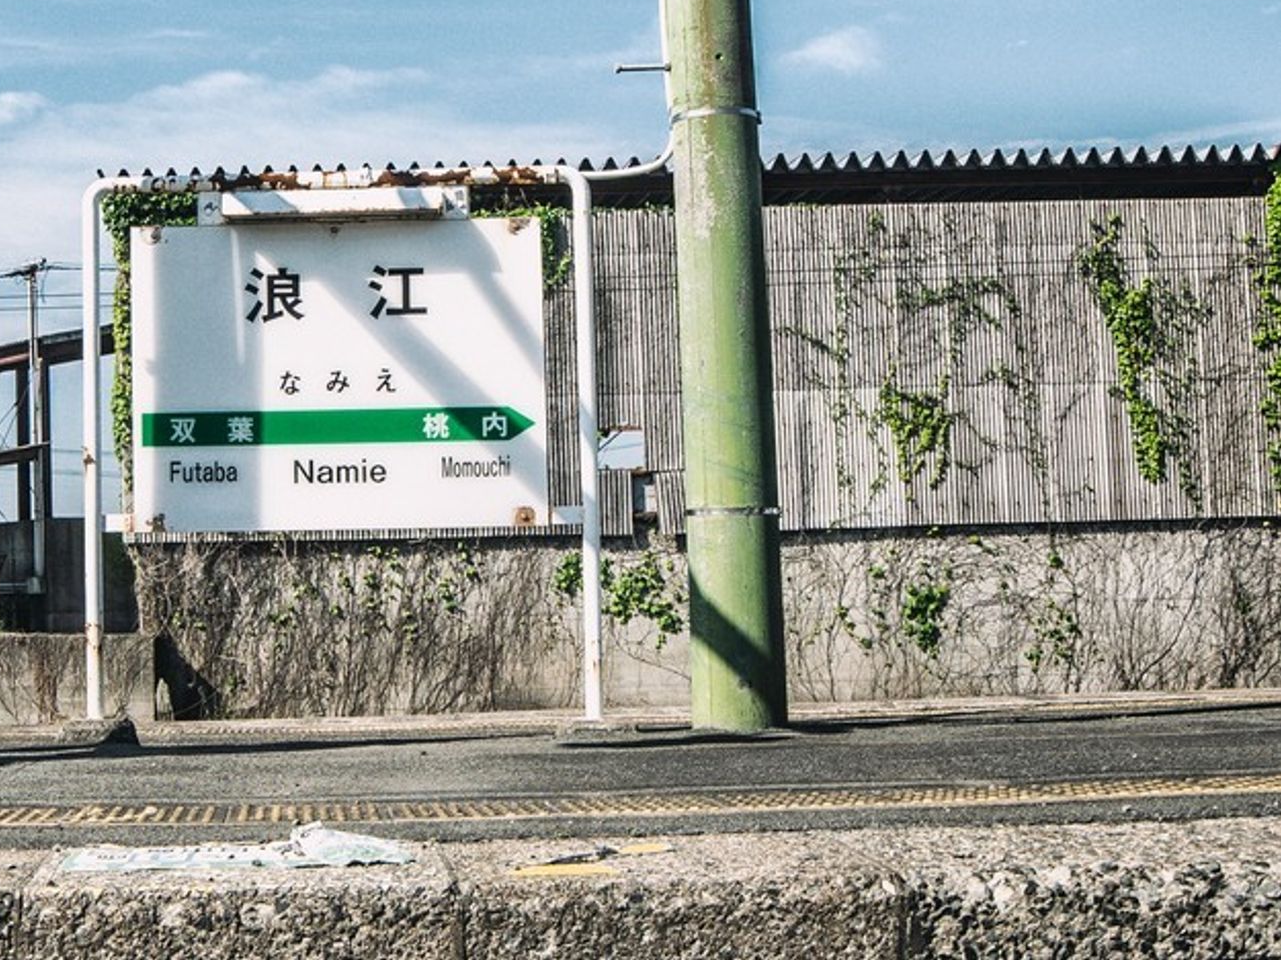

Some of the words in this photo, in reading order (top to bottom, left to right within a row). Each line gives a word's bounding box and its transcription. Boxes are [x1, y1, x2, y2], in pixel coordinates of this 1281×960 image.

[244, 265, 428, 323] 浪江
[280, 368, 397, 395] なみえ
[170, 417, 254, 443] 双葉
[423, 412, 508, 439] 桃内
[169, 461, 238, 483] Futaba
[293, 458, 387, 484] Namie
[441, 455, 511, 478] Momouchi
